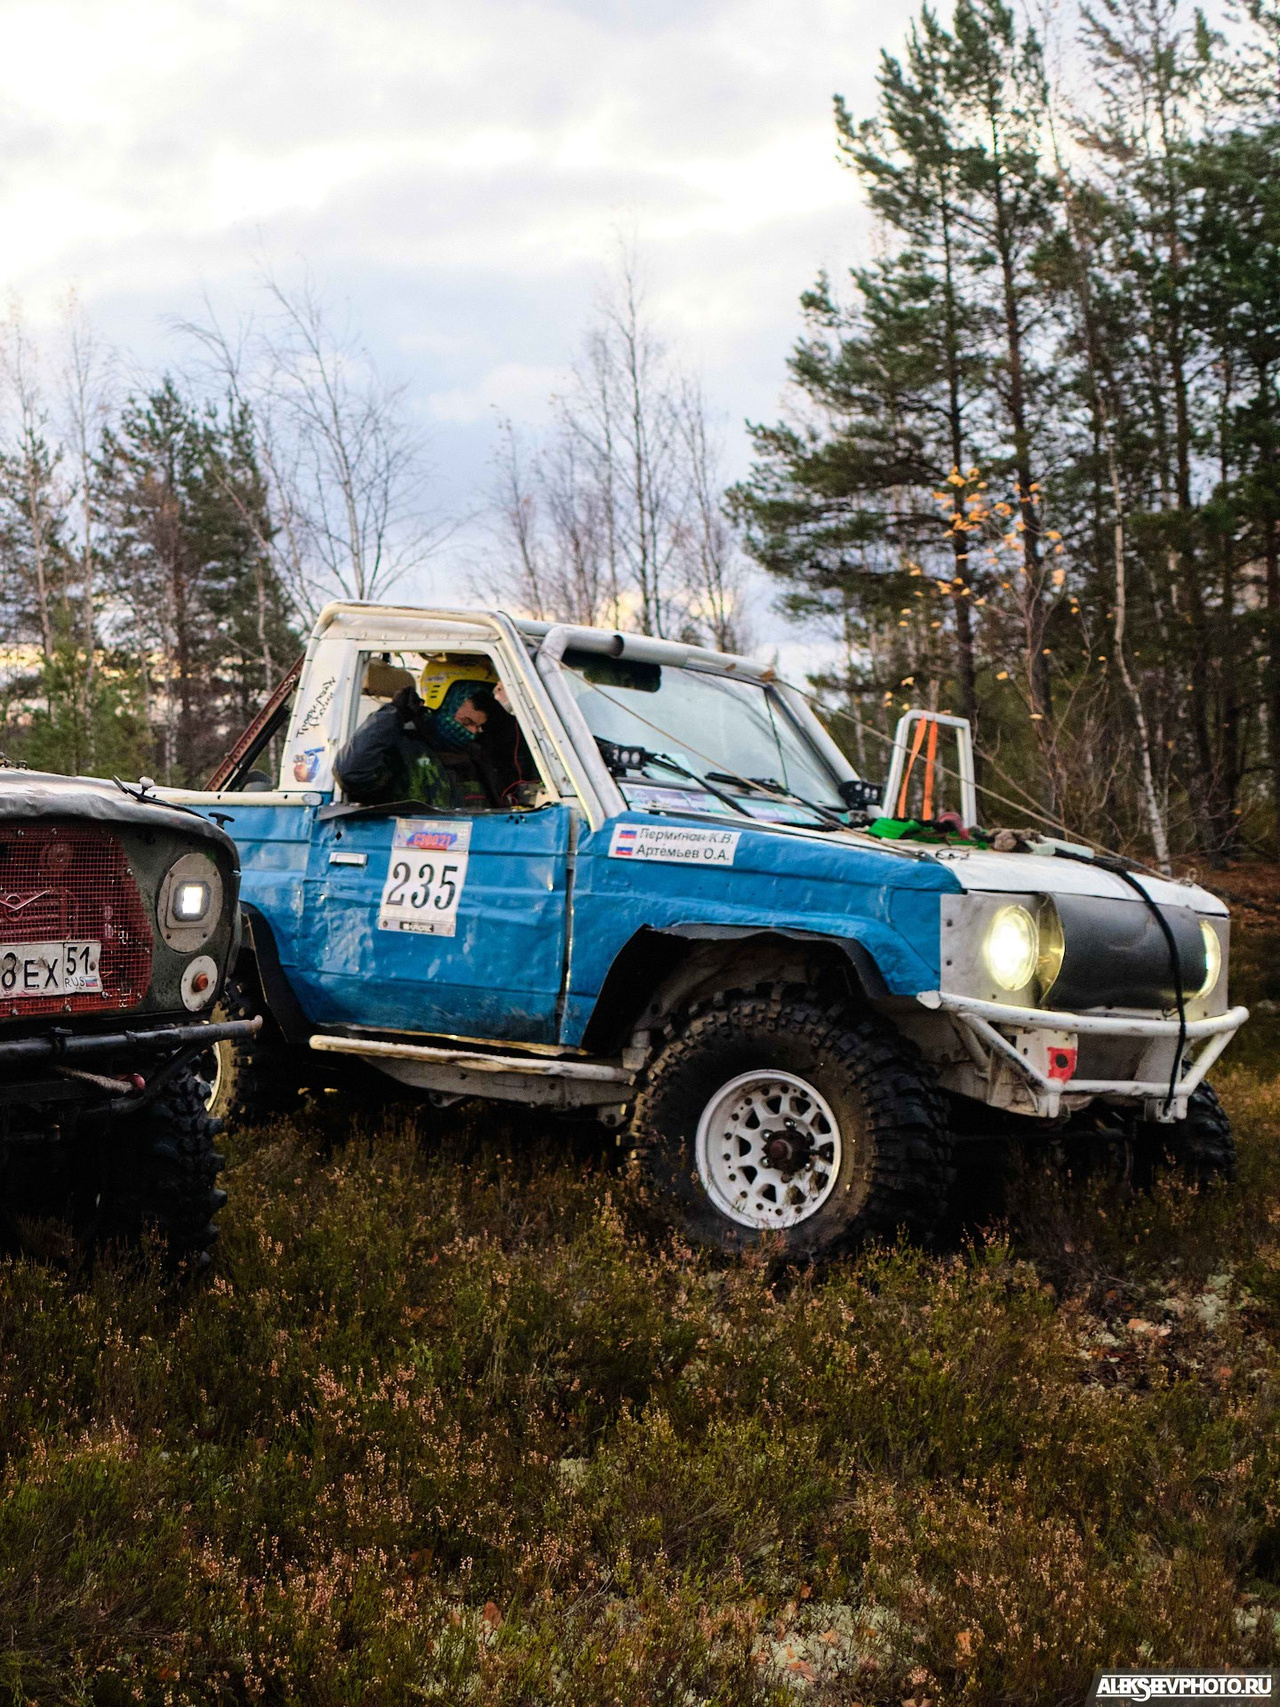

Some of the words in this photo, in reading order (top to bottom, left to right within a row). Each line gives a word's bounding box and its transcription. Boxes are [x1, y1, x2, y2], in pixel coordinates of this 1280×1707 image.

[386, 861, 458, 910] 235
[66, 945, 91, 976] 51
[64, 977, 85, 988] RUS
